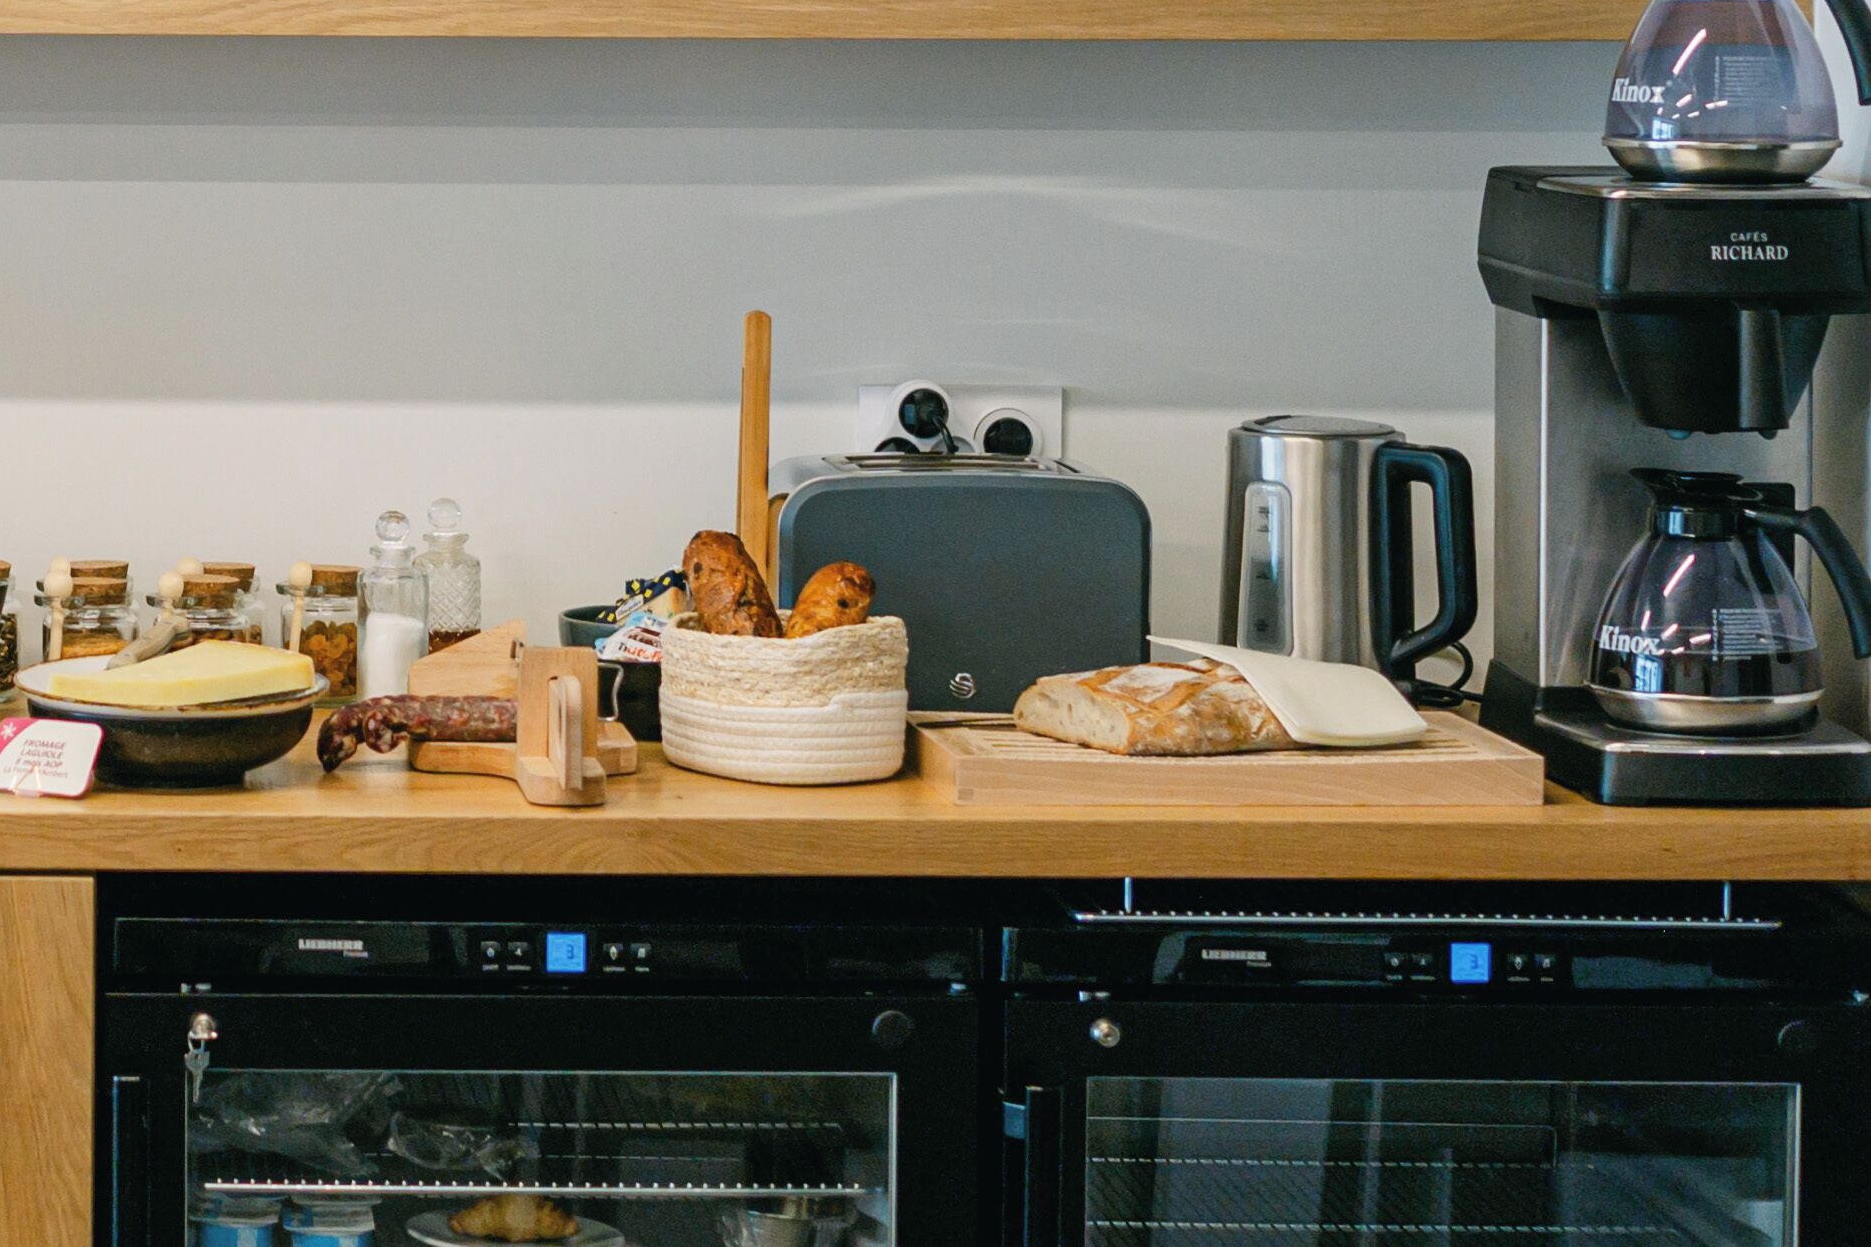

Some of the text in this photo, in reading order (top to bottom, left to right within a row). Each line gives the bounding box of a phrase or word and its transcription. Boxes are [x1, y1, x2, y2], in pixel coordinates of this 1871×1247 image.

[1611, 76, 1666, 104] Kinox
[1730, 231, 1768, 242] CAFÉS
[1710, 245, 1789, 260] RICHARD
[1599, 624, 1661, 655] Kinox
[24, 739, 66, 751] FROMAGE
[44, 760, 63, 768] AOP
[566, 944, 575, 960] 3
[1470, 954, 1479, 970] 3
